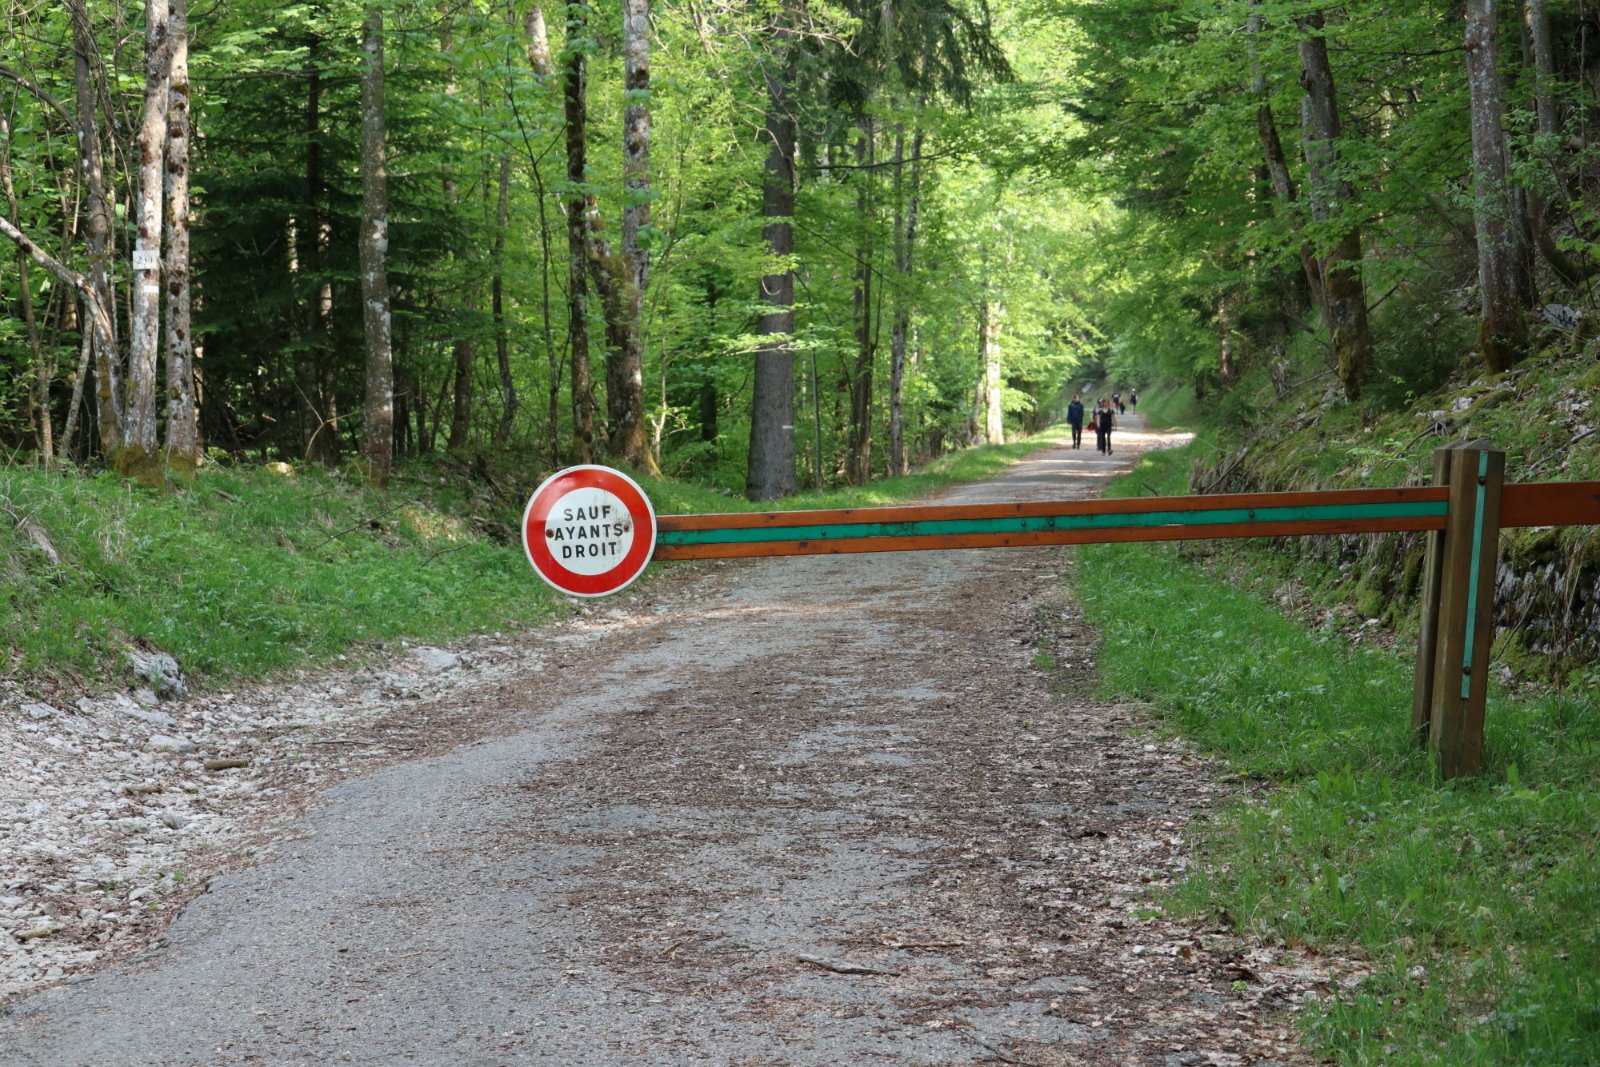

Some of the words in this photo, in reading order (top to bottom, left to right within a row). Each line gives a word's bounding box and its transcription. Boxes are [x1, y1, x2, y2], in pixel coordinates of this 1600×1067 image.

[563, 505, 611, 522] SAUF
[554, 523, 624, 541] AYANTS
[562, 542, 617, 559] DROIT
